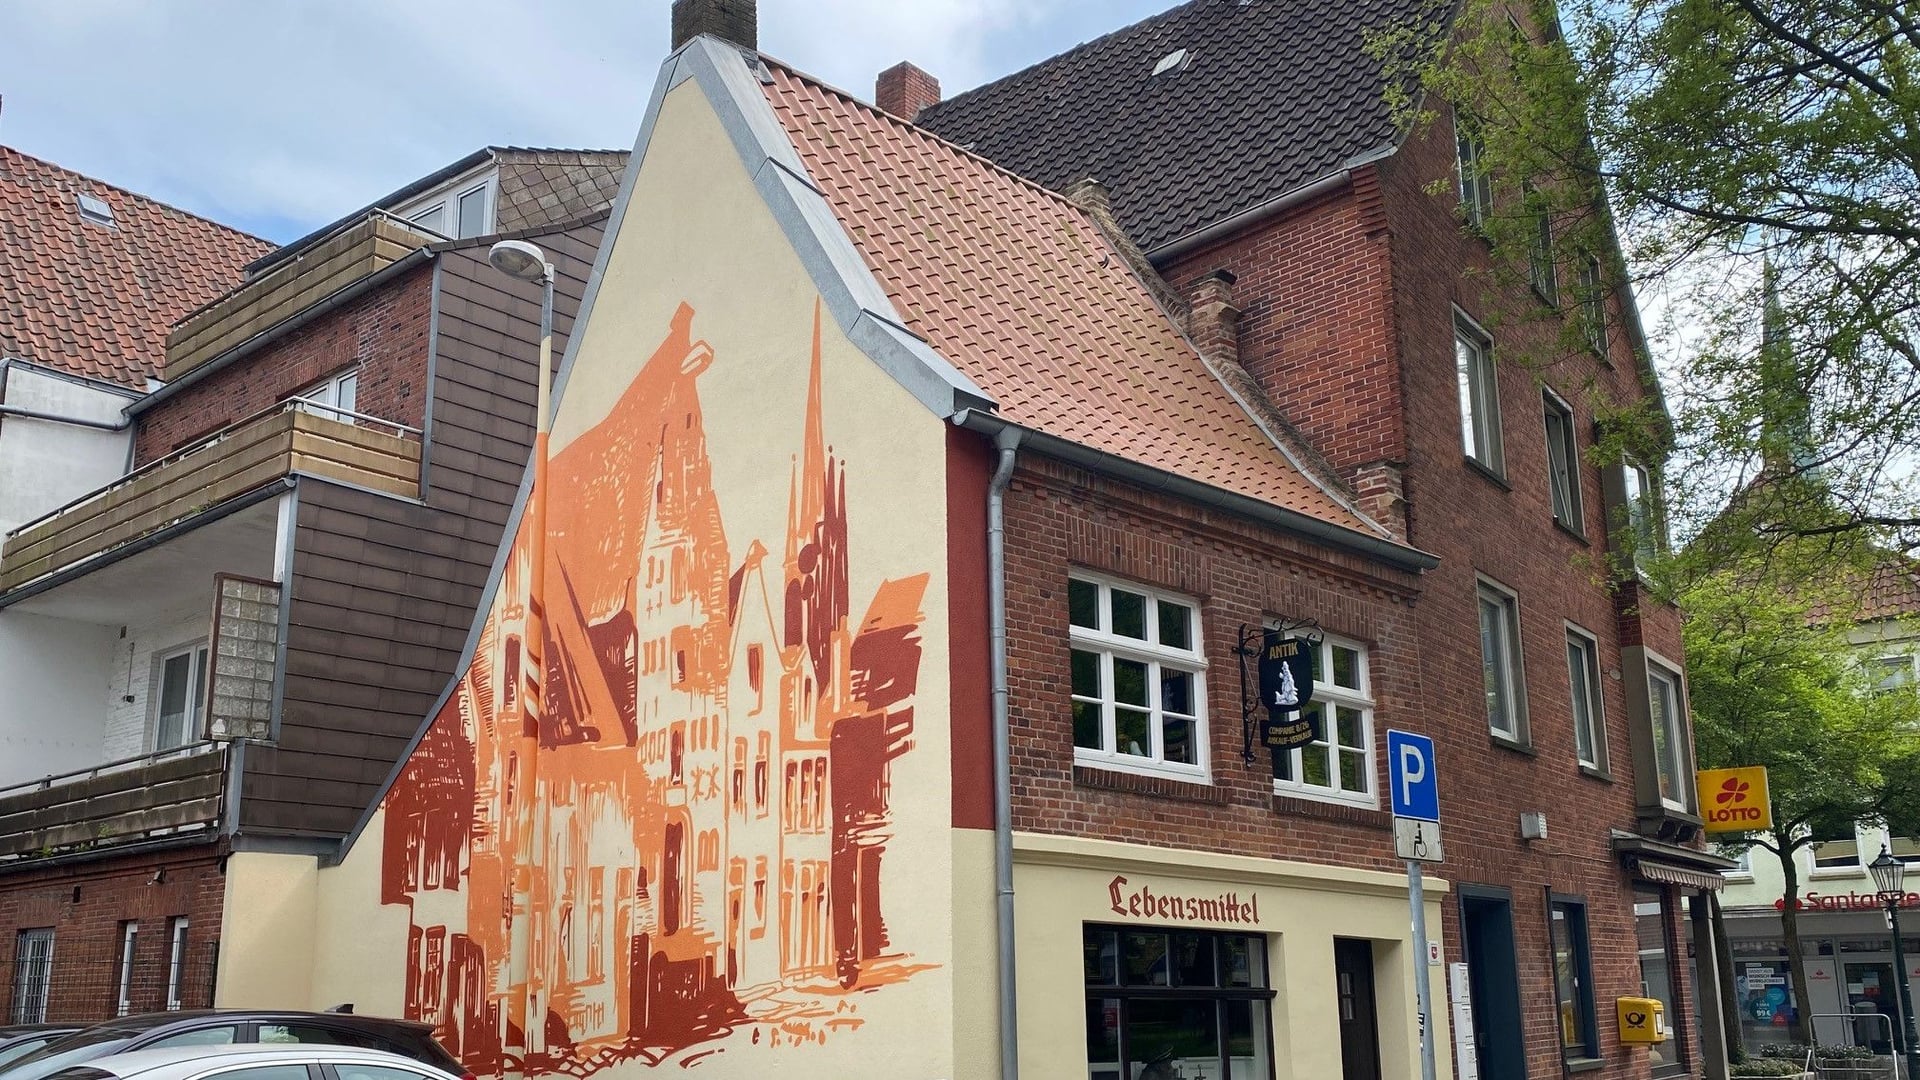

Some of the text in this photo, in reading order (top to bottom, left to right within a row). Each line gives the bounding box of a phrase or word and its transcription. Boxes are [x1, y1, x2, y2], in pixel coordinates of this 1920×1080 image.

[1269, 642, 1298, 659] ANTIK
[1400, 744, 1425, 806] P
[1708, 807, 1761, 822] LOTTO
[1109, 875, 1260, 925] Lebensmittel
